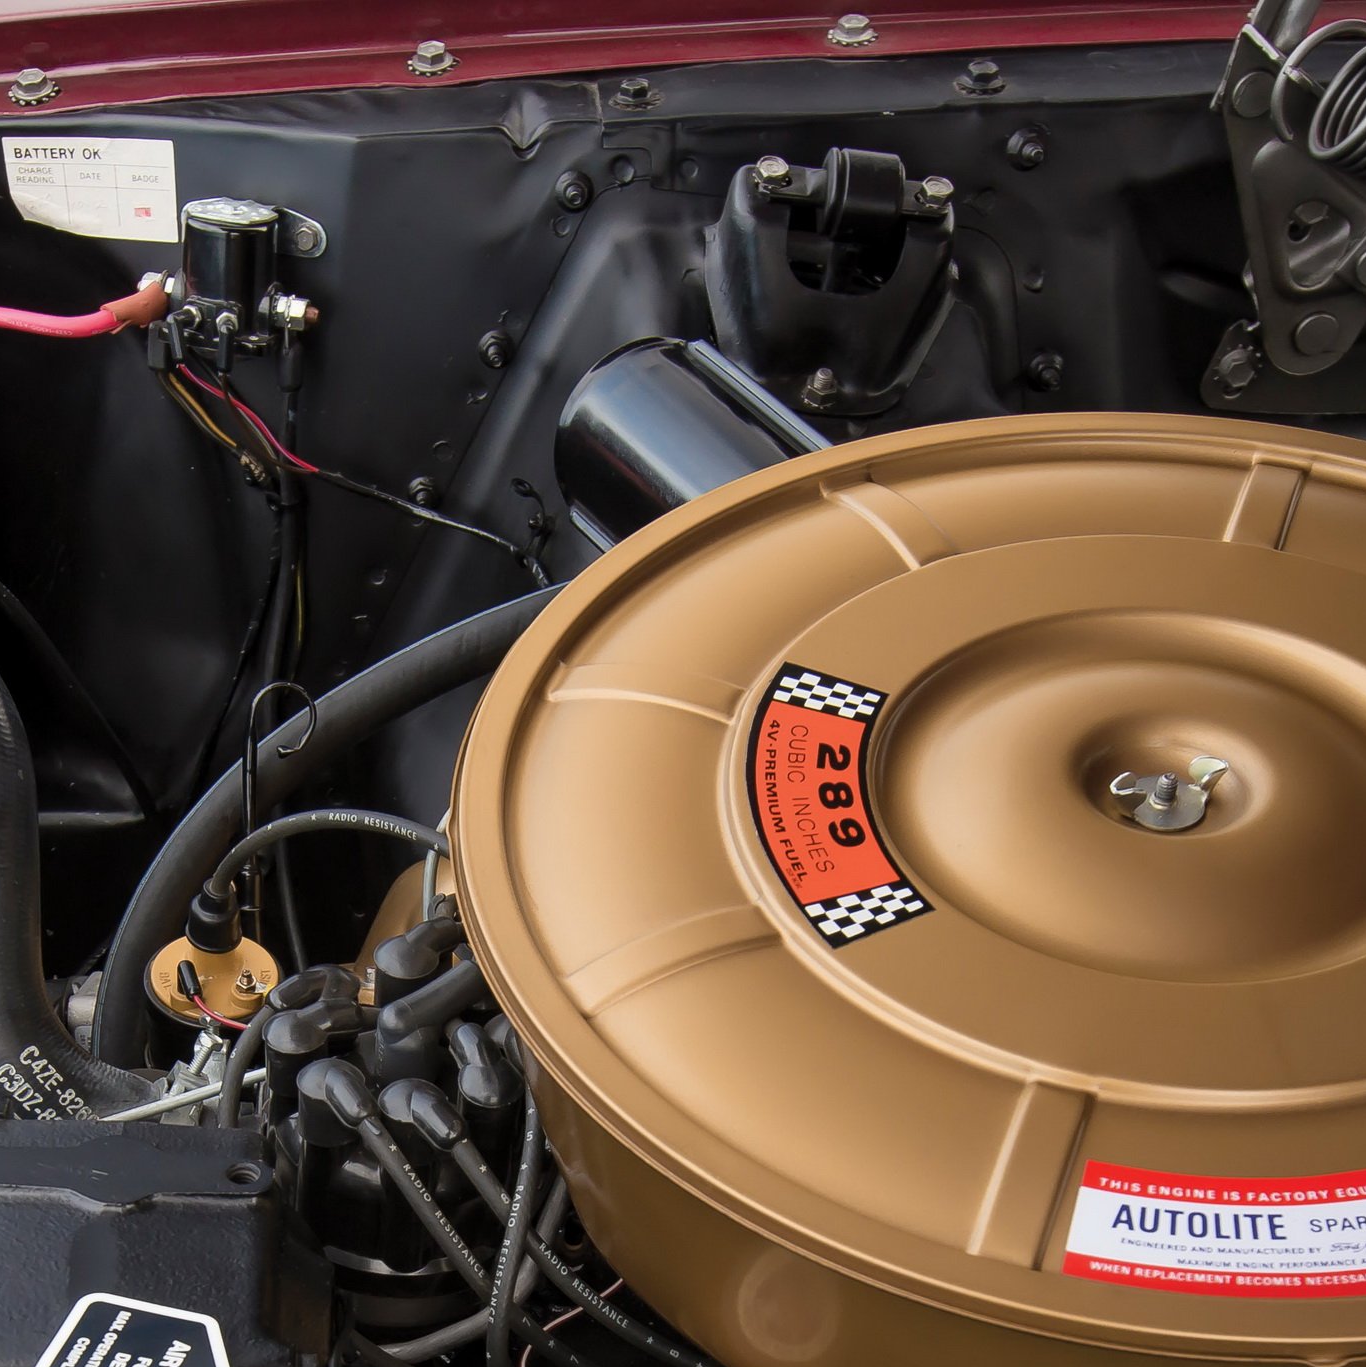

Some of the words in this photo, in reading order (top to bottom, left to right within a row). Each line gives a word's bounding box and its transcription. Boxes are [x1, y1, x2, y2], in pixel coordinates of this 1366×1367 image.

[14, 148, 75, 160] BATTERY
[82, 149, 102, 160] OK
[18, 167, 53, 175] CHARGE
[80, 172, 101, 181] DATE
[132, 175, 159, 184] BADGE
[787, 724, 808, 783] CUBIC
[816, 742, 866, 848] 289
[328, 812, 358, 823] RADIO
[364, 816, 417, 841] RESISTANCE
[793, 797, 835, 873] INCHES
[780, 838, 808, 882] FUEL
[526, 1131, 533, 1141] 5
[1099, 1176, 1142, 1193] THIS
[1147, 1184, 1216, 1200] ENGINE
[1223, 1190, 1241, 1201] IS
[1247, 1190, 1329, 1203] FACTORY
[402, 1163, 432, 1202] RADIO
[435, 1209, 486, 1279] RESISTANCE
[507, 1185, 525, 1228] RADIO
[1111, 1203, 1288, 1240] AUTOLITE
[1121, 1237, 1187, 1252] ENGINEERED
[1191, 1246, 1213, 1254] AND
[1217, 1247, 1304, 1256] MANUFACTURED
[1088, 1260, 1131, 1275] WHEN
[1134, 1268, 1232, 1284] REPLACEMENT
[1236, 1276, 1302, 1287] BECOMES
[1177, 1258, 1232, 1268] MAXIMUM
[1236, 1261, 1275, 1269] ENGINE
[1279, 1258, 1356, 1269] PERFORMANCE
[487, 1239, 511, 1325] RESISTANCE
[537, 1241, 569, 1277] RADIO
[571, 1277, 629, 1329] RESISTANCE
